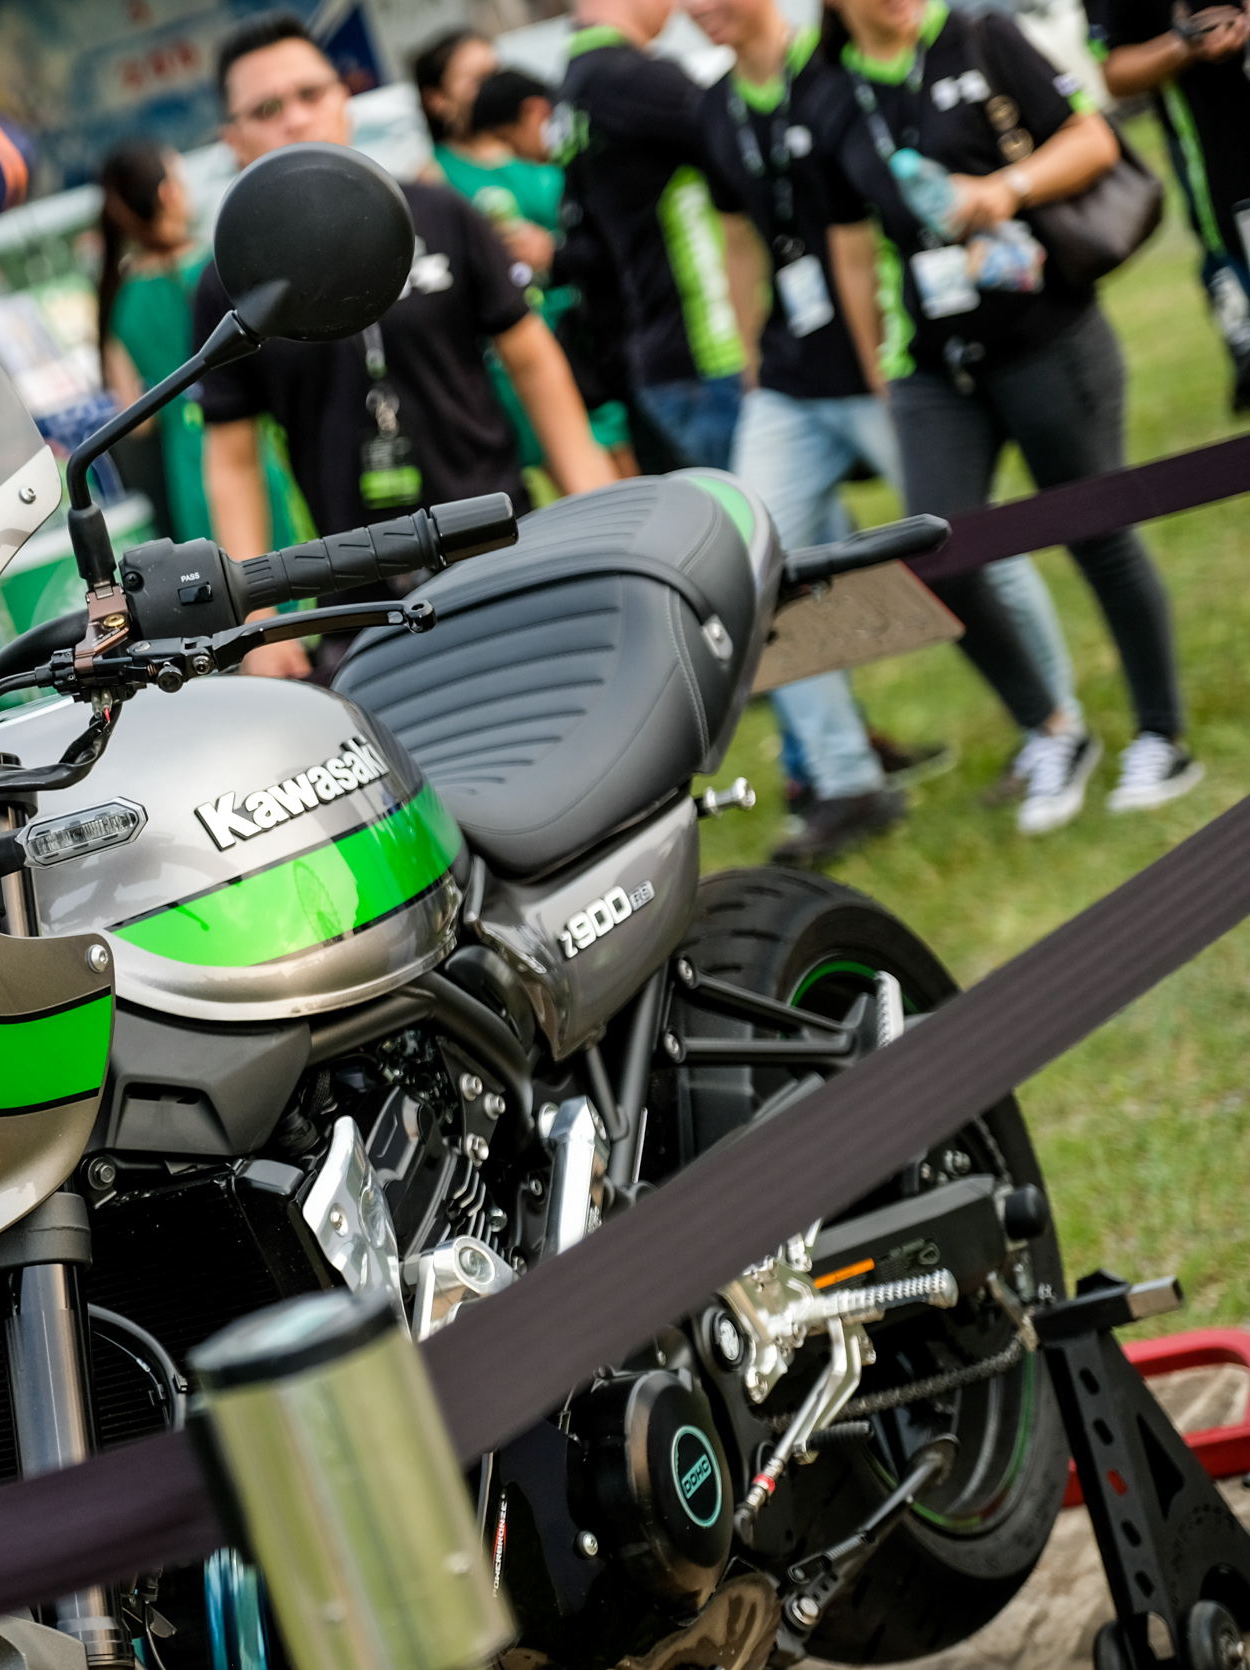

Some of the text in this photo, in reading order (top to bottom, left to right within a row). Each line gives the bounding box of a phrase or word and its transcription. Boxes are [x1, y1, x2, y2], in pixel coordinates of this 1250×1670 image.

[180, 571, 200, 583] PASS
[195, 734, 390, 851] Kawasaki
[683, 1459, 711, 1494] DOHC
[492, 1500, 508, 1598] POWERBRONZE
